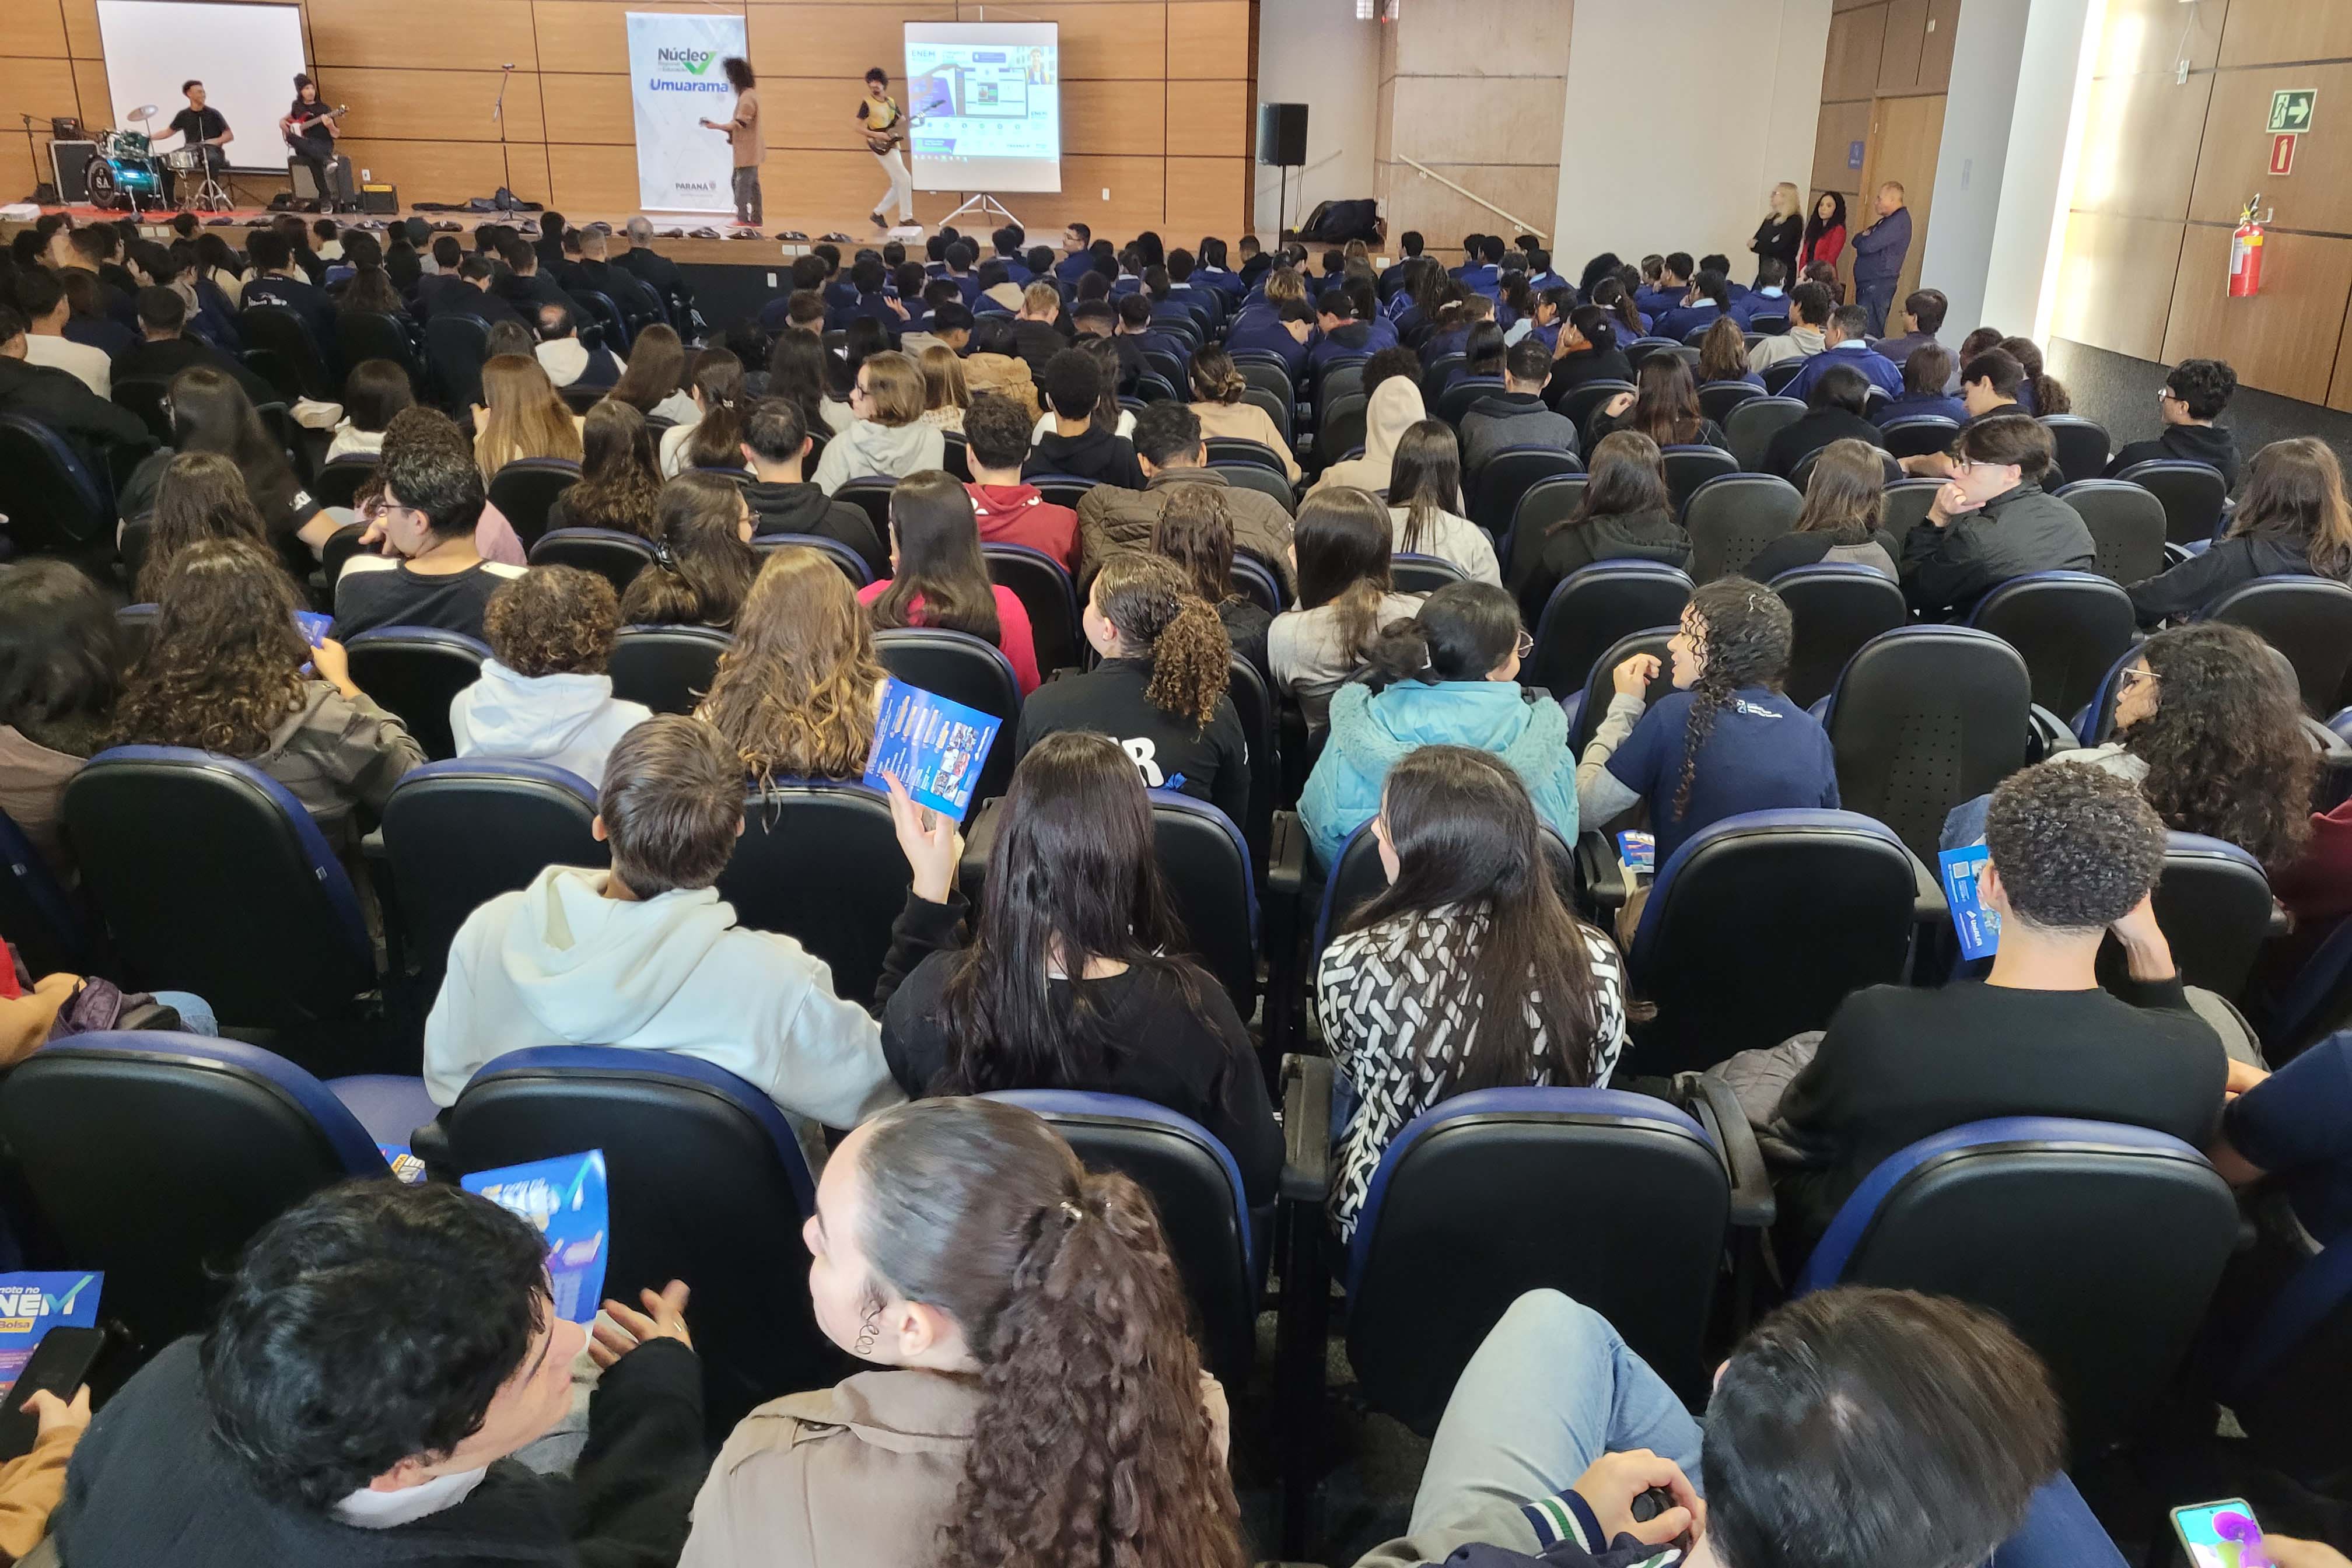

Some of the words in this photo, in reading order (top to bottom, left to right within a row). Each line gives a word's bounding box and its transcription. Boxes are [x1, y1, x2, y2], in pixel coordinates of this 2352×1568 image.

[658, 47, 709, 61] Núcleo
[650, 78, 729, 92] Umuarama
[1115, 737, 1165, 789] R
[0, 1284, 85, 1316] NEM
